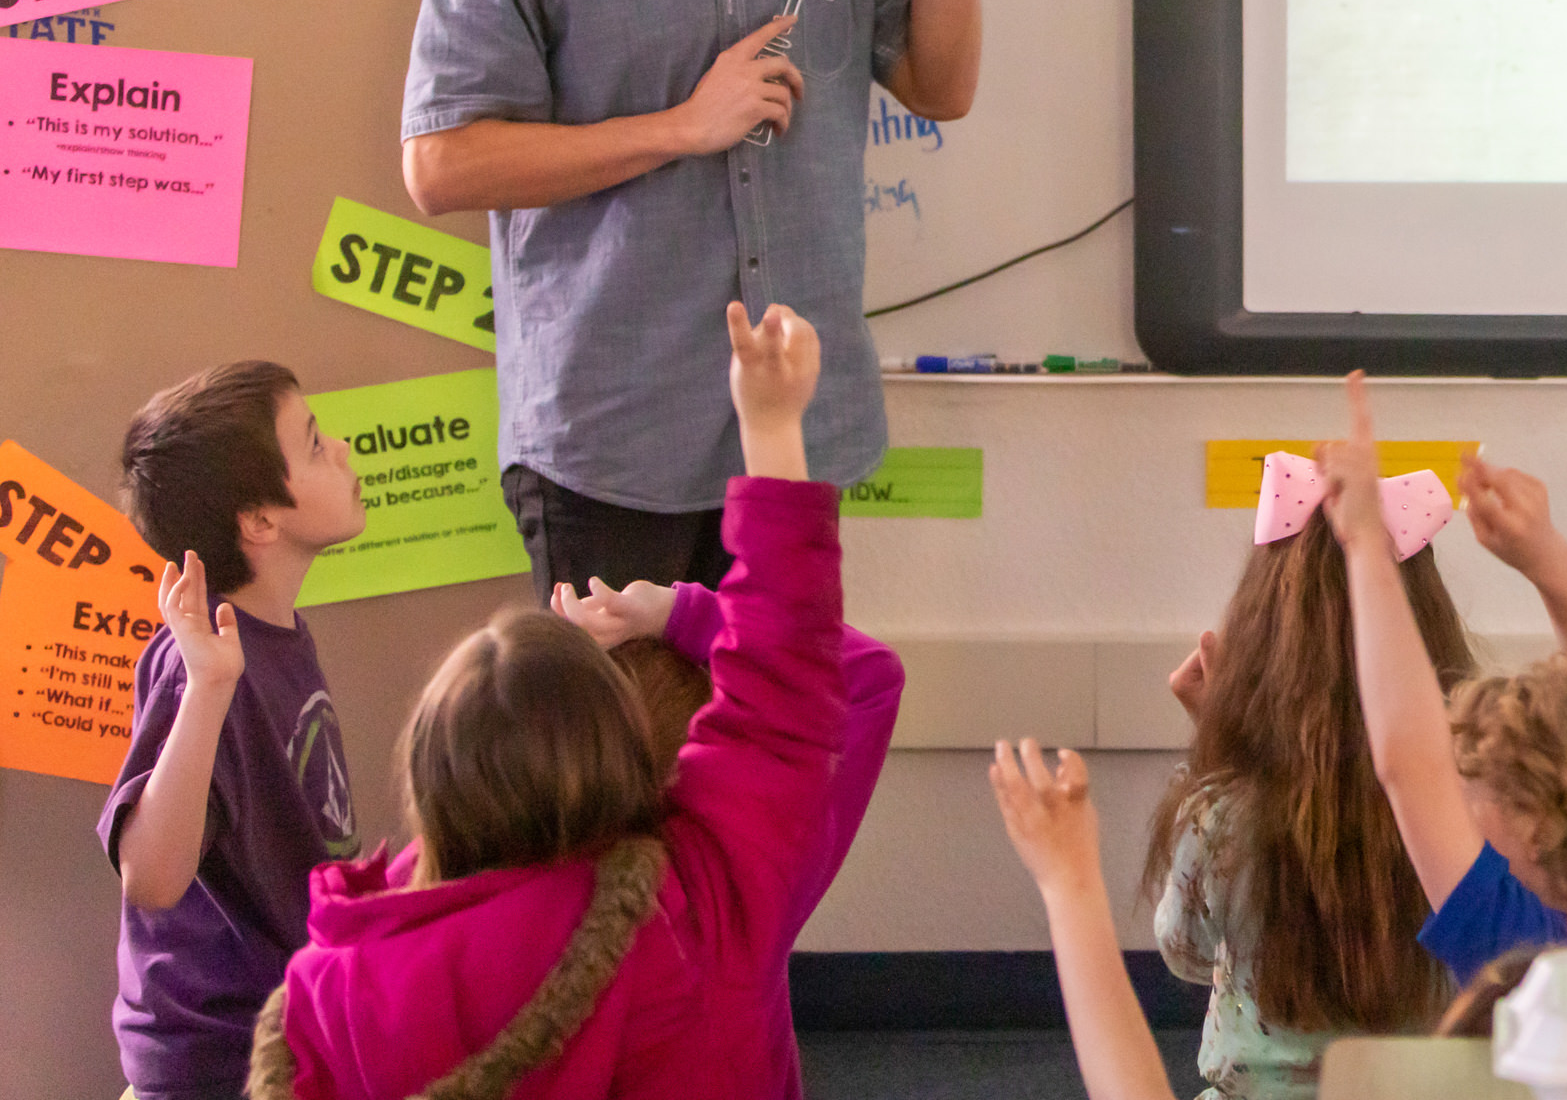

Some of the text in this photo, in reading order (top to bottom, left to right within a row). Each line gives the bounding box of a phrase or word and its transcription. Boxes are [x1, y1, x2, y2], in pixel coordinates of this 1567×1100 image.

[50, 72, 182, 113] Explain
[75, 120, 88, 135] is
[93, 124, 123, 141] my
[66, 168, 104, 186] first
[109, 172, 149, 192] step
[331, 233, 466, 312] STEP
[344, 415, 470, 455] aluate
[0, 480, 112, 571] STEP
[81, 672, 112, 690] still
[99, 724, 133, 738] you
